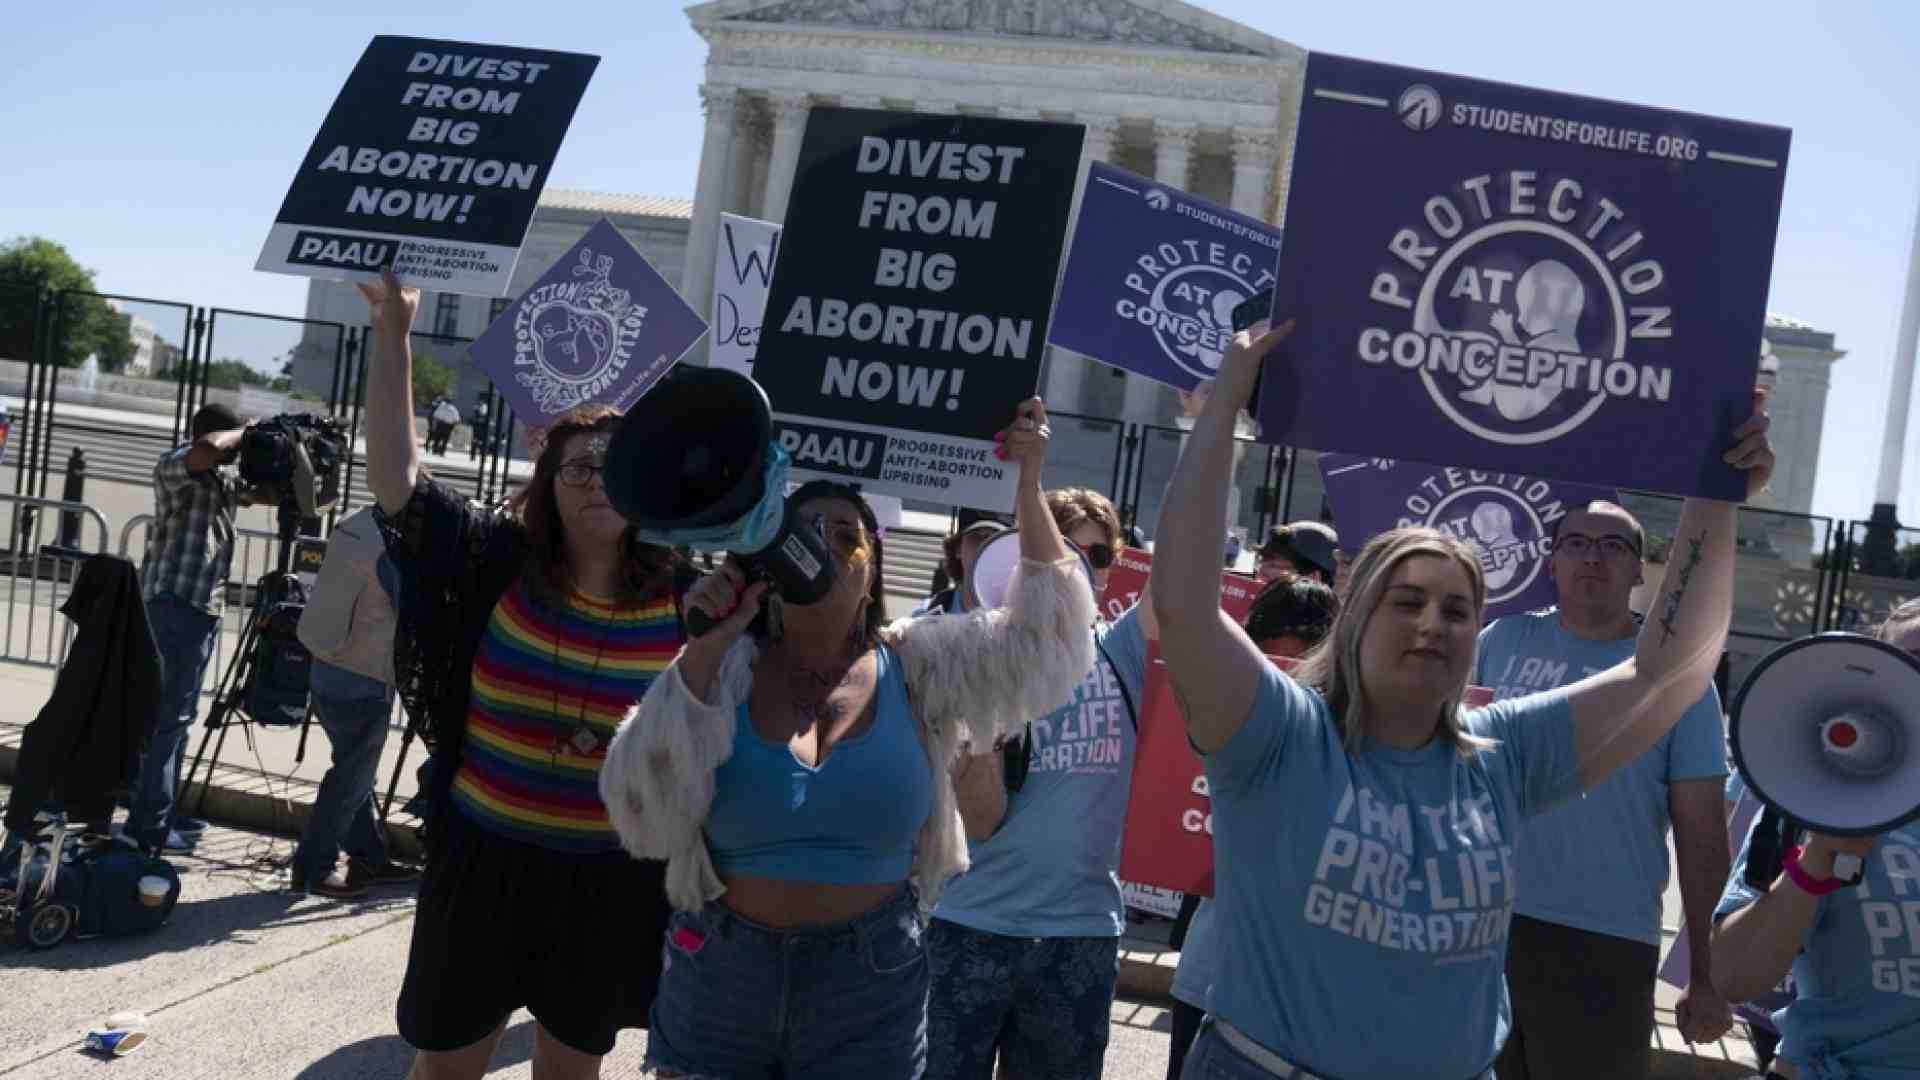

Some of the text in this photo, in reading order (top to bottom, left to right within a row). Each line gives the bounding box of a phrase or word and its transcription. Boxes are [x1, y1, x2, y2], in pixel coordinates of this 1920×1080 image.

[405, 51, 550, 84] DIVEST
[400, 82, 521, 114] FROM
[407, 116, 480, 145] BIG
[1451, 103, 1699, 161] STUDENTSFORLIFE.ORG
[318, 145, 538, 190] ABORTION
[856, 136, 1025, 184] DIVEST
[346, 186, 475, 225] NOW!
[858, 190, 998, 240] FROM
[299, 237, 388, 267] PAAU
[397, 254, 499, 273] ANTI-ABORTION
[401, 241, 489, 260] PROGRESSIVE
[874, 248, 957, 292] BIG
[1124, 239, 1276, 296] PROTECT
[1369, 170, 1673, 340] PROTECTION
[1173, 281, 1211, 305] AT
[1449, 265, 1513, 303] AT
[513, 281, 580, 366] PROTECTION
[780, 296, 1033, 360] ABORTION
[582, 303, 649, 400] CONCEPTION
[1357, 328, 1672, 402] CONCEPTION
[820, 356, 965, 412] NOW!
[778, 429, 875, 470] PAAU
[884, 455, 1005, 481] ANTI-ABORTION
[888, 438, 988, 462] PROGRESSIVE
[882, 469, 951, 490] UPRISING
[1333, 781, 1357, 825] I
[1356, 786, 1414, 856] AM
